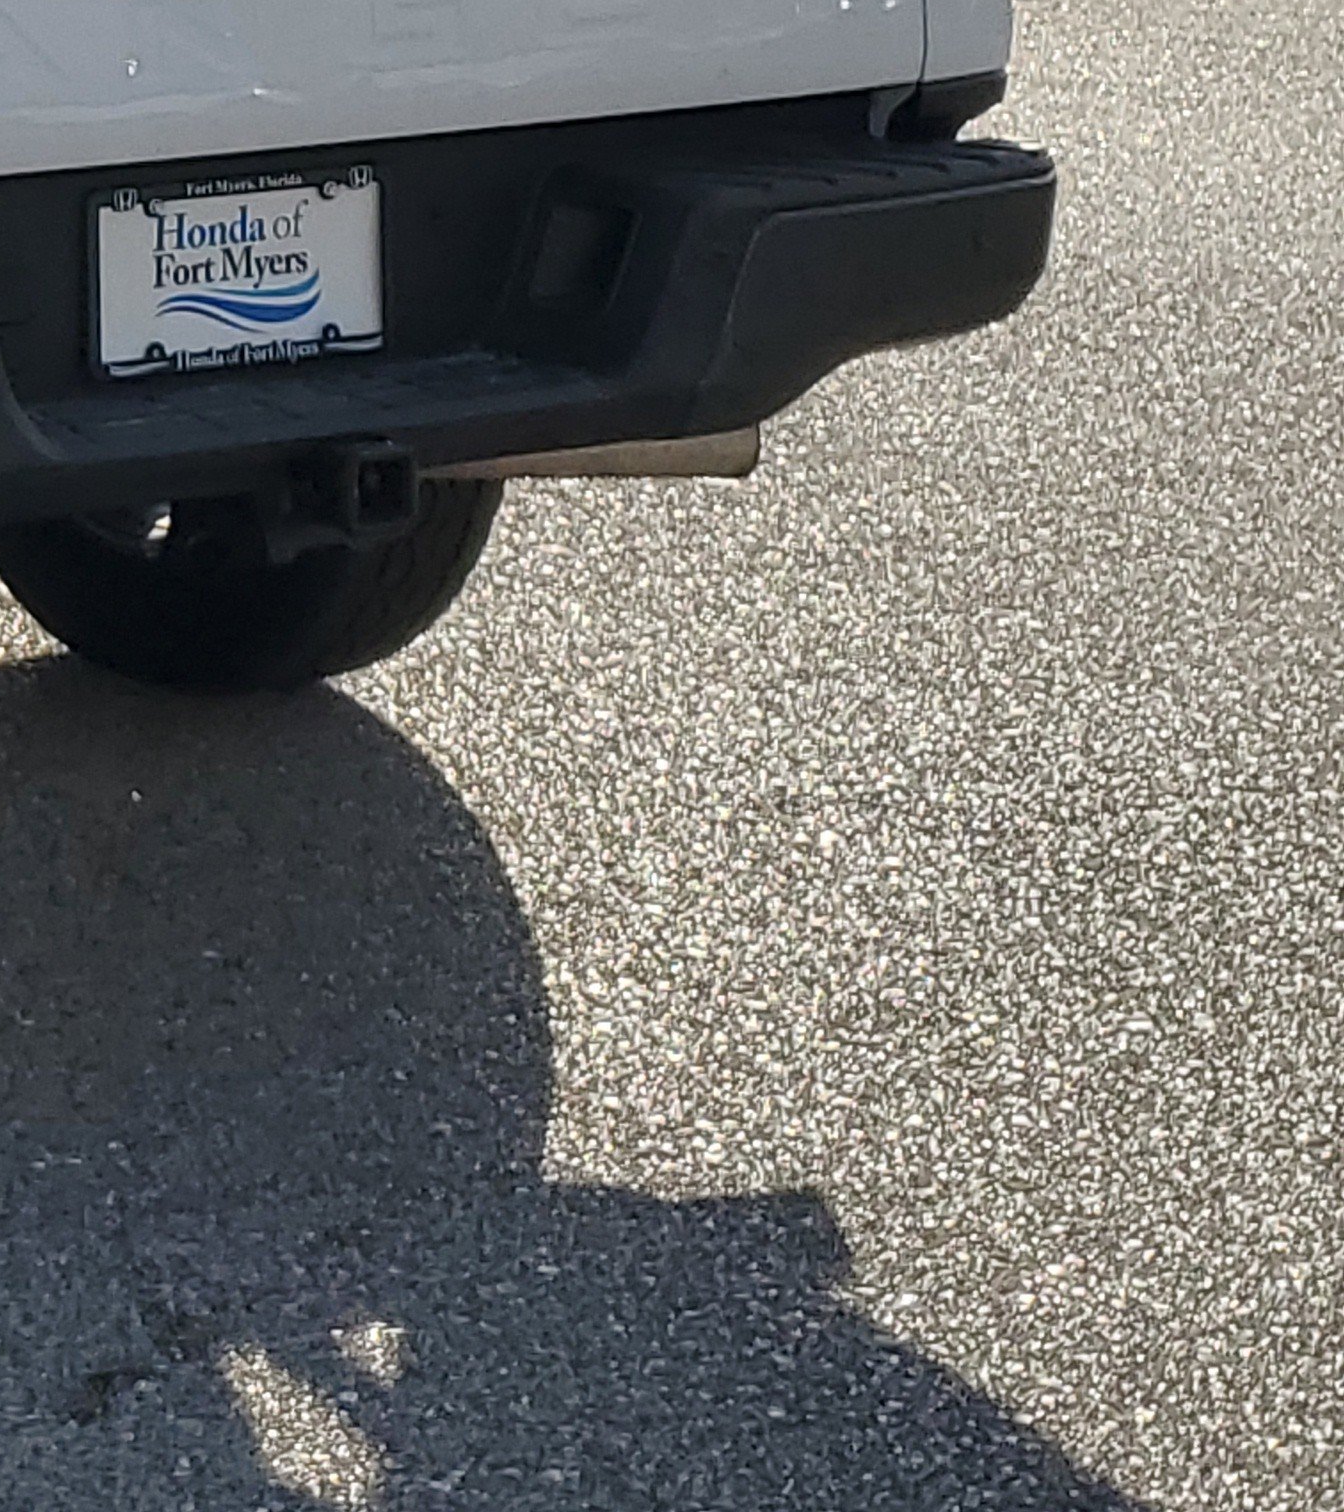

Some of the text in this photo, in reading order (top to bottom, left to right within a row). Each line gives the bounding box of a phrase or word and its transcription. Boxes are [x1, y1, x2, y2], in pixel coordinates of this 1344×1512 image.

[185, 178, 213, 197] Fort
[257, 172, 303, 189] Florida
[153, 198, 309, 252] Honda of
[153, 245, 309, 289] Fort Myers
[176, 339, 319, 372] Honda of Fort Myers
